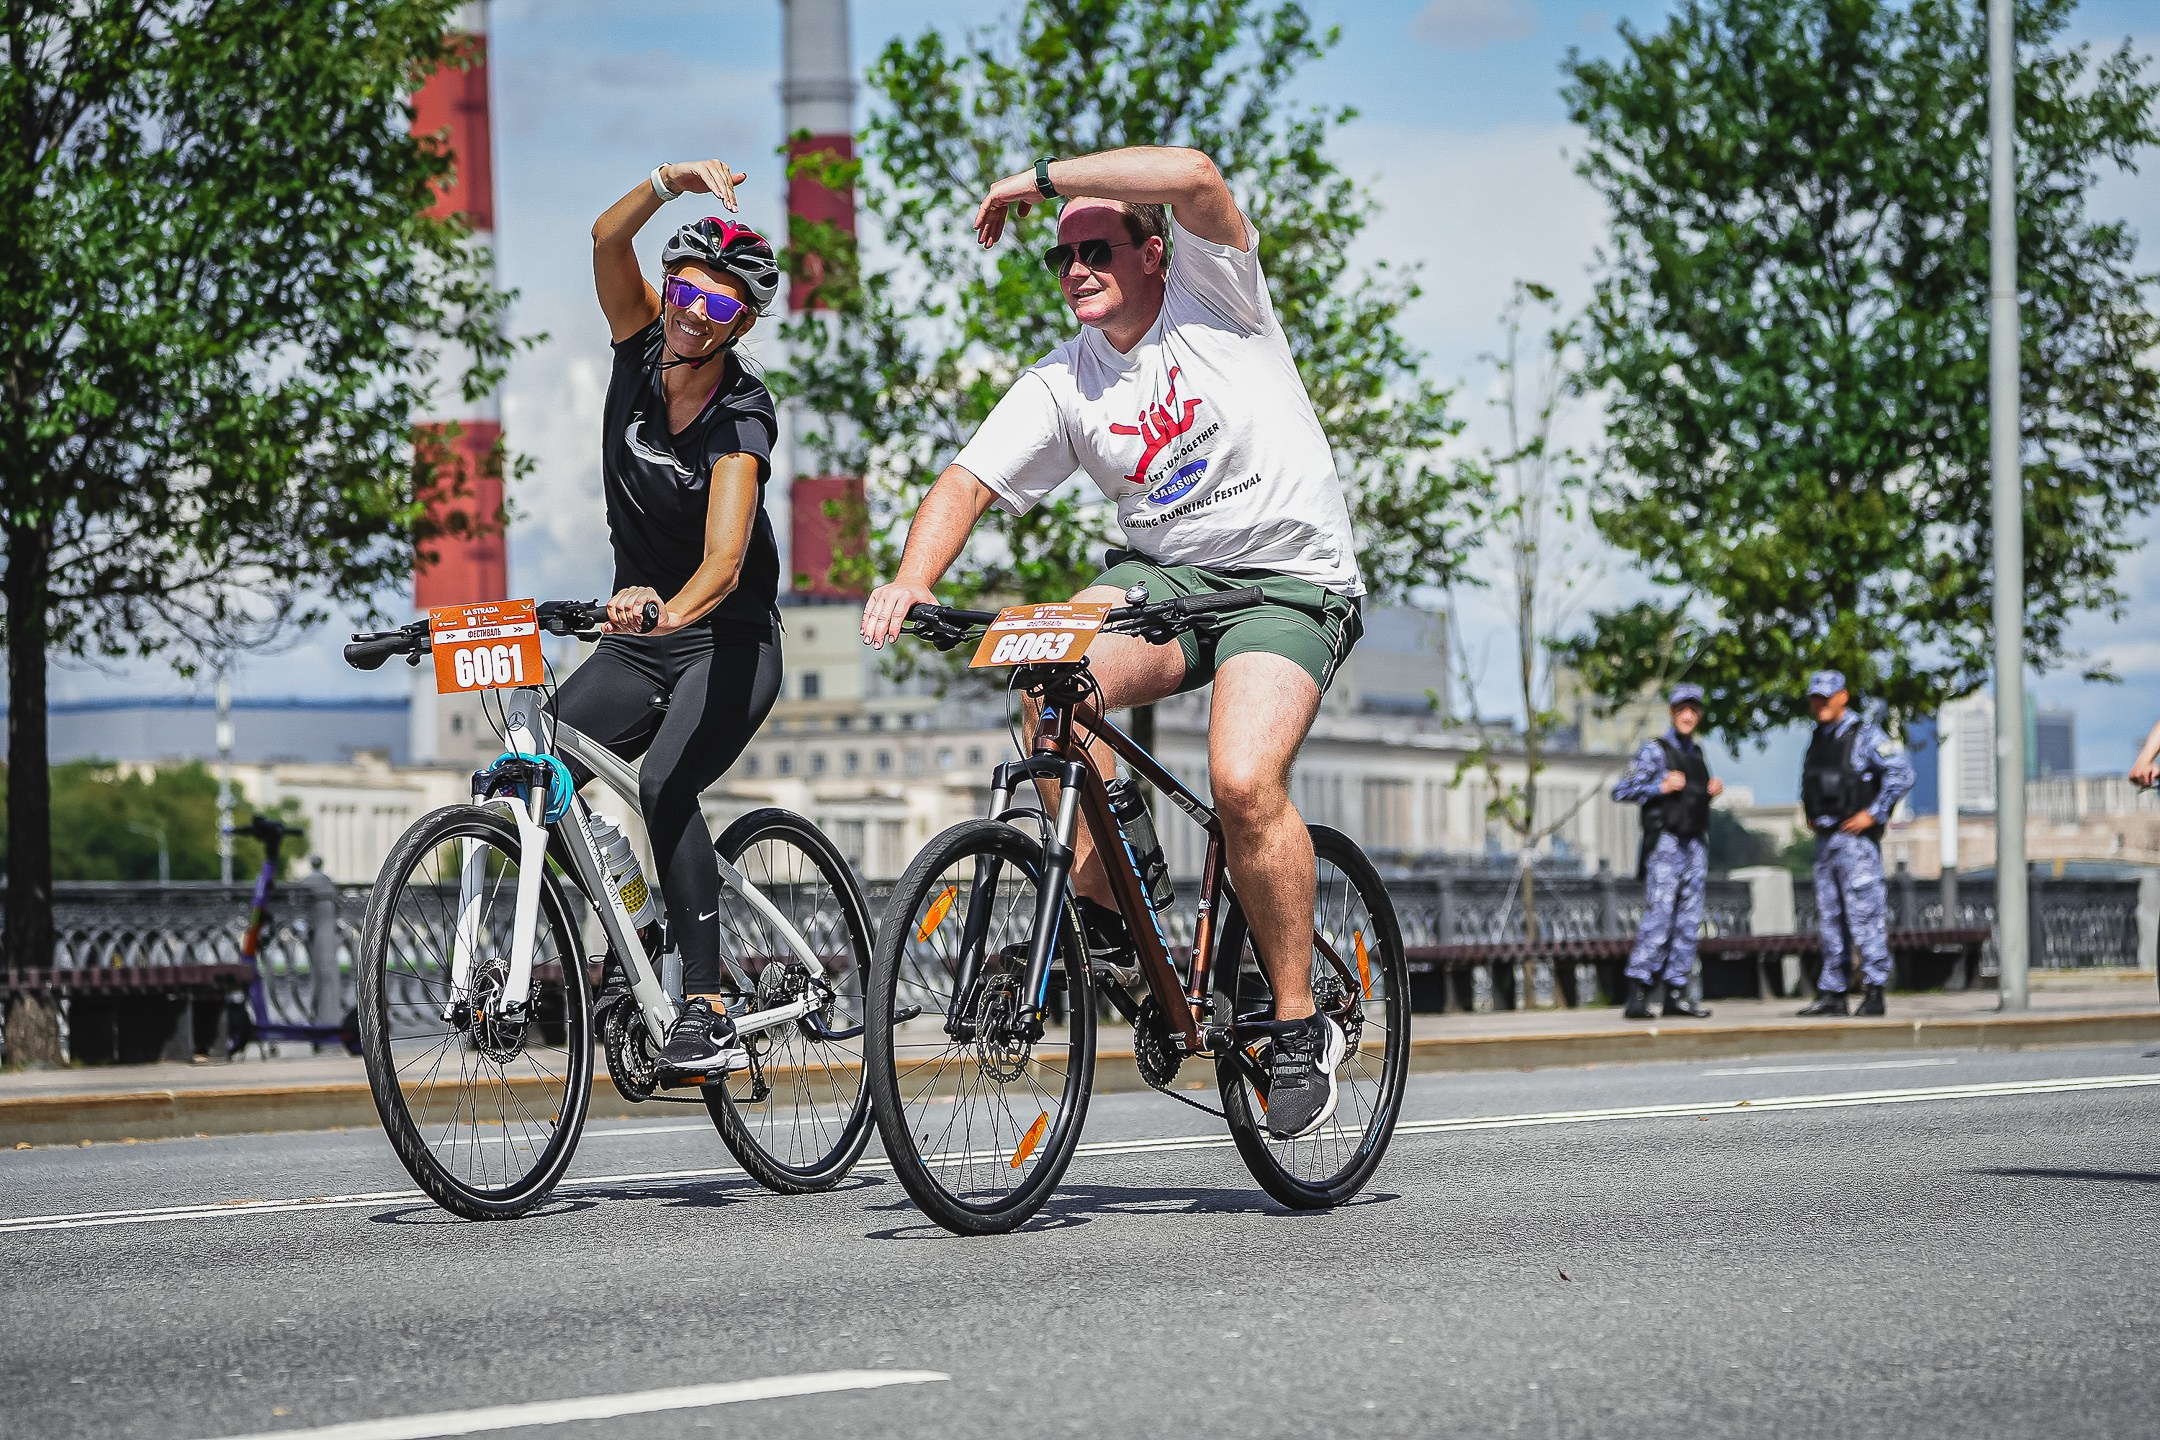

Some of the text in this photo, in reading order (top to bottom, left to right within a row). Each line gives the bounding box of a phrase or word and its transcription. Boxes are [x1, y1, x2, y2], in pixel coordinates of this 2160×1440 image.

[1163, 453, 1180, 472] UN
[1180, 422, 1219, 458] OGETHER
[1152, 468, 1206, 500] SAMSUNG
[1159, 495, 1213, 524] RUNNING
[1214, 472, 1262, 503] FESTIVAL
[462, 605, 500, 616] LA STRADA
[467, 627, 502, 639] ФЕСТИВАЛЬ
[990, 632, 1076, 664] 6063
[454, 643, 524, 688] 6061
